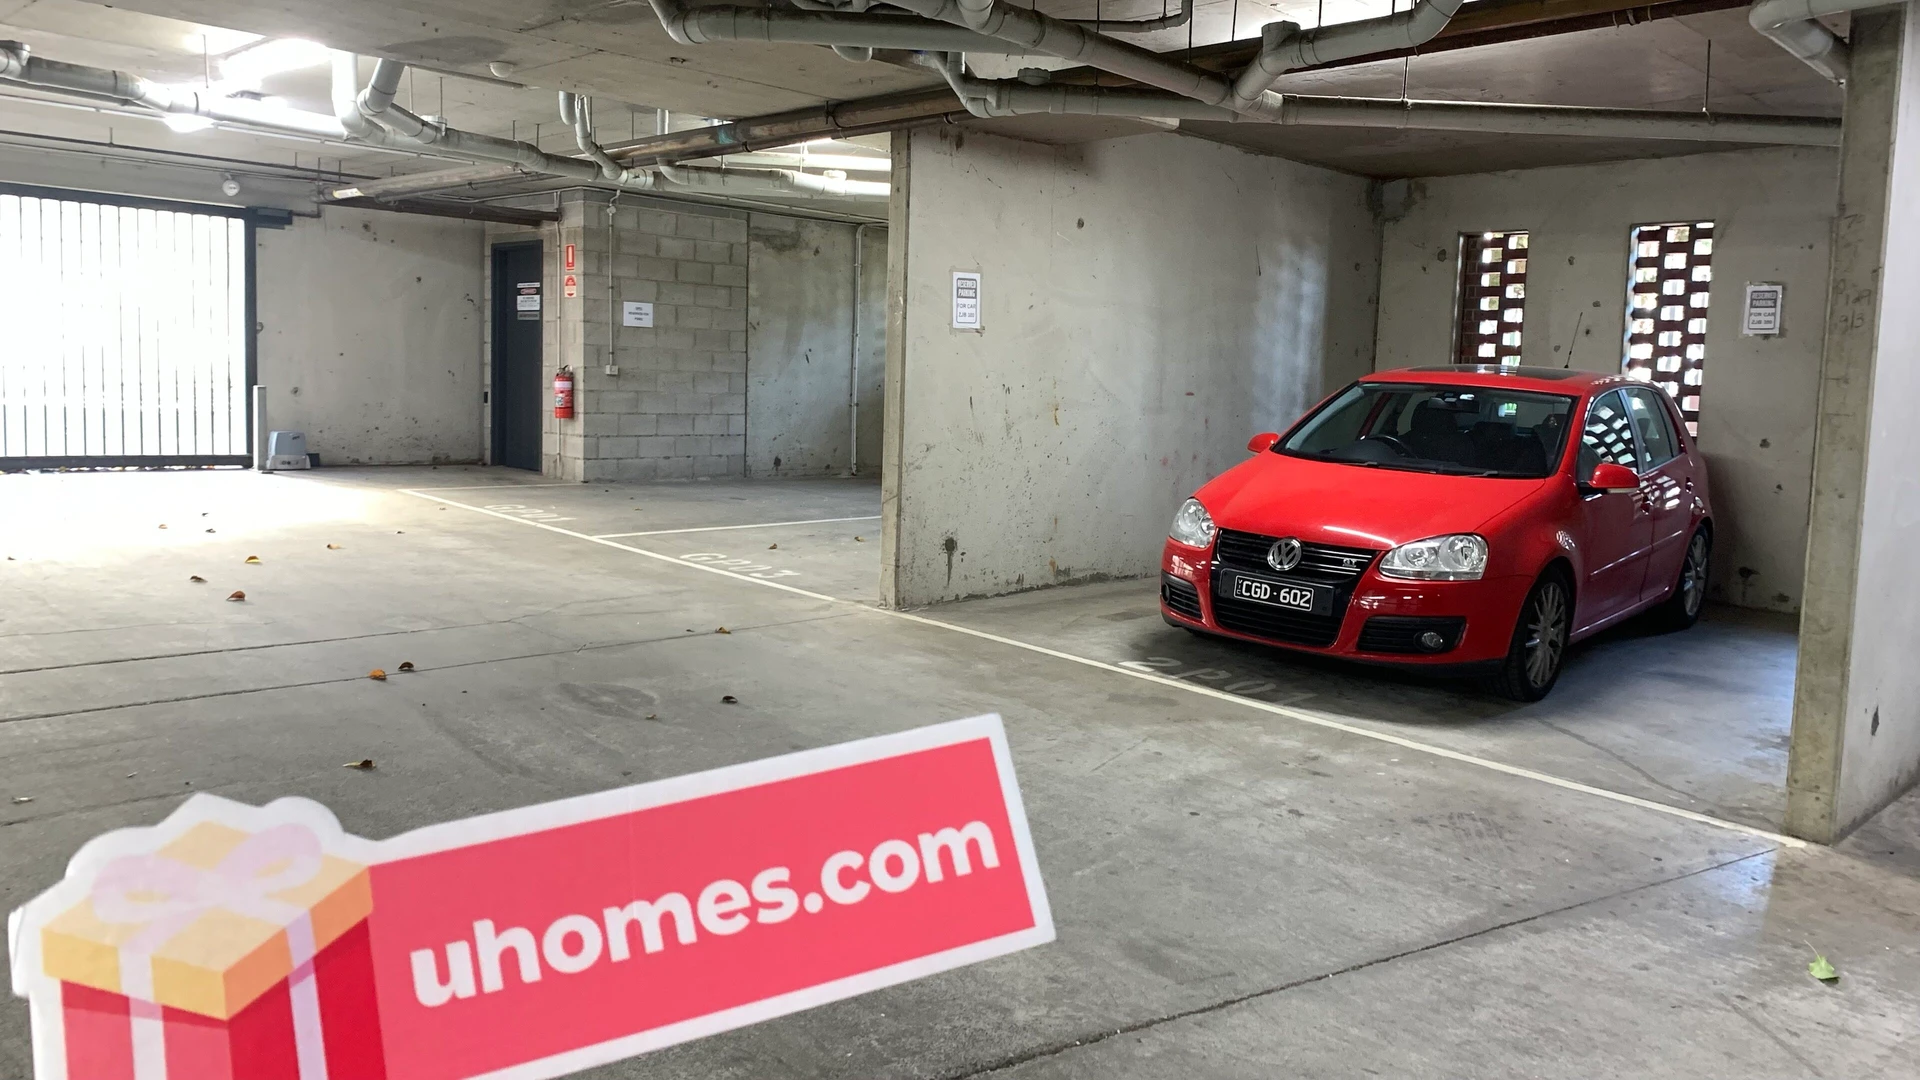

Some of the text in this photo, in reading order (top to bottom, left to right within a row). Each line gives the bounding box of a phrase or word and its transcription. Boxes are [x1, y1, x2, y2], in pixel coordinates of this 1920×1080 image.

[958, 288, 977, 297] PARKING
[679, 553, 801, 579] GP03
[409, 819, 1001, 1008] uhomes.com
